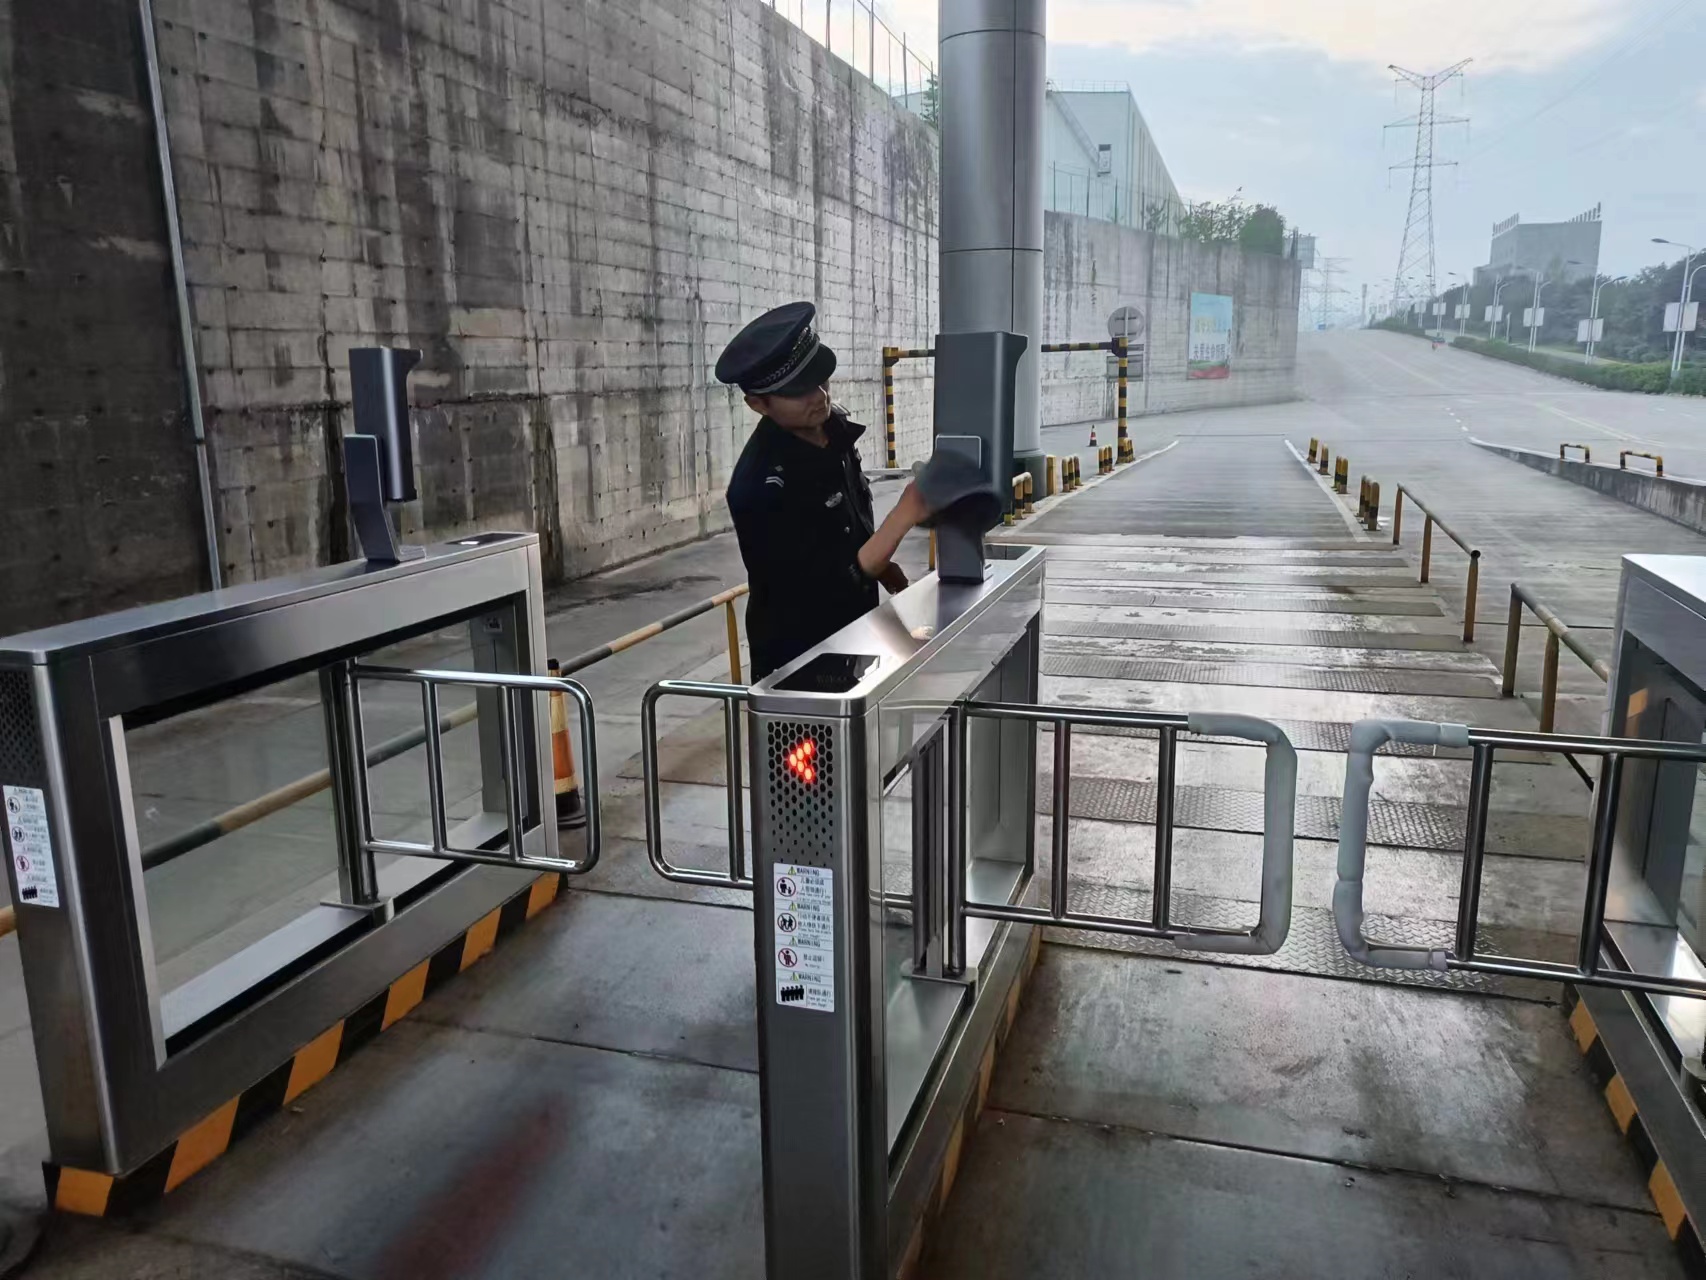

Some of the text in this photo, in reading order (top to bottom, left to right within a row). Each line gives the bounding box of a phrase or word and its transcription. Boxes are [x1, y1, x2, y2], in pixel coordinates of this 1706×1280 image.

[797, 868, 820, 877] WARNING
[797, 904, 820, 912] WARNING
[798, 939, 820, 947] WARNING
[799, 973, 821, 982] WARNING
